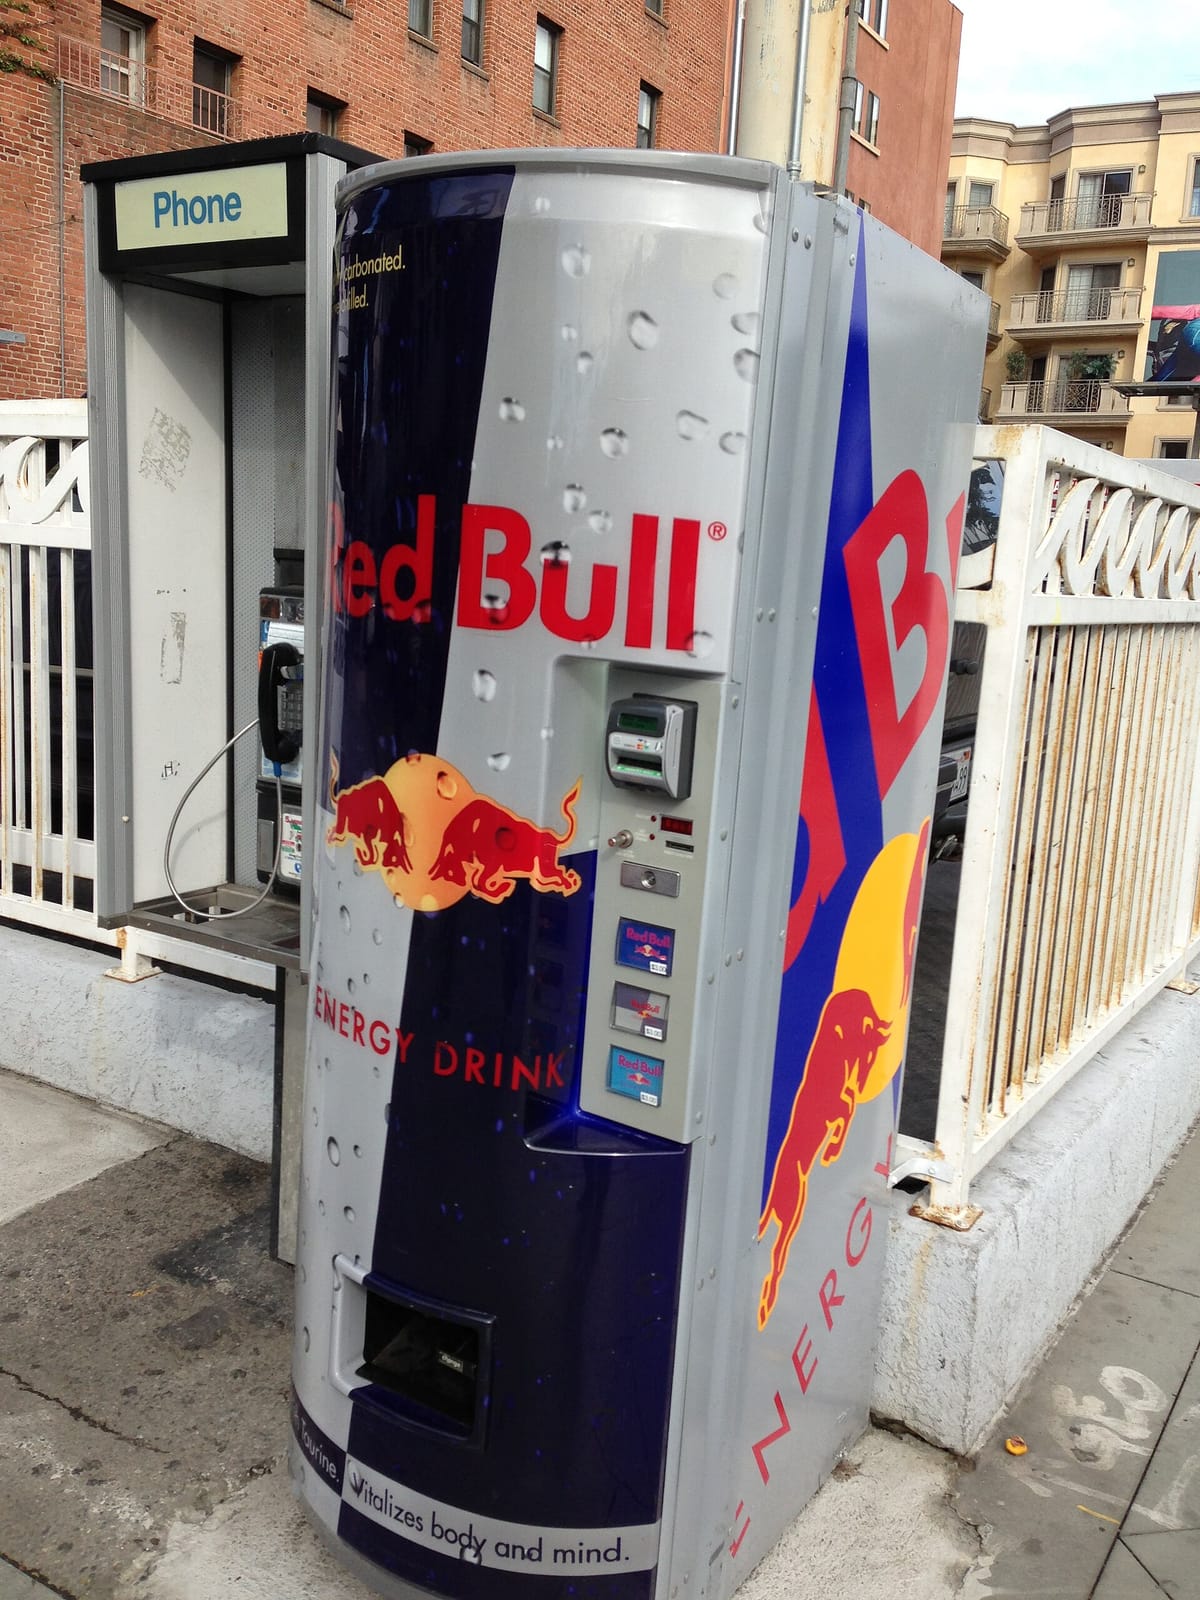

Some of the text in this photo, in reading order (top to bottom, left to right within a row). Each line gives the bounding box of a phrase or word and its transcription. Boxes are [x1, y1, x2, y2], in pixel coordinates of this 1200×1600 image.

[153, 190, 242, 229] Phone
[343, 244, 406, 282] carbonated.
[457, 503, 701, 651] Bull
[626, 928, 671, 948] Red Bull
[315, 984, 565, 1091] ENERGY DRINK
[618, 1055, 662, 1077] Red Bull
[301, 1417, 341, 1483] Taurine.
[350, 1468, 630, 1564] Vitalizes body and mind.
